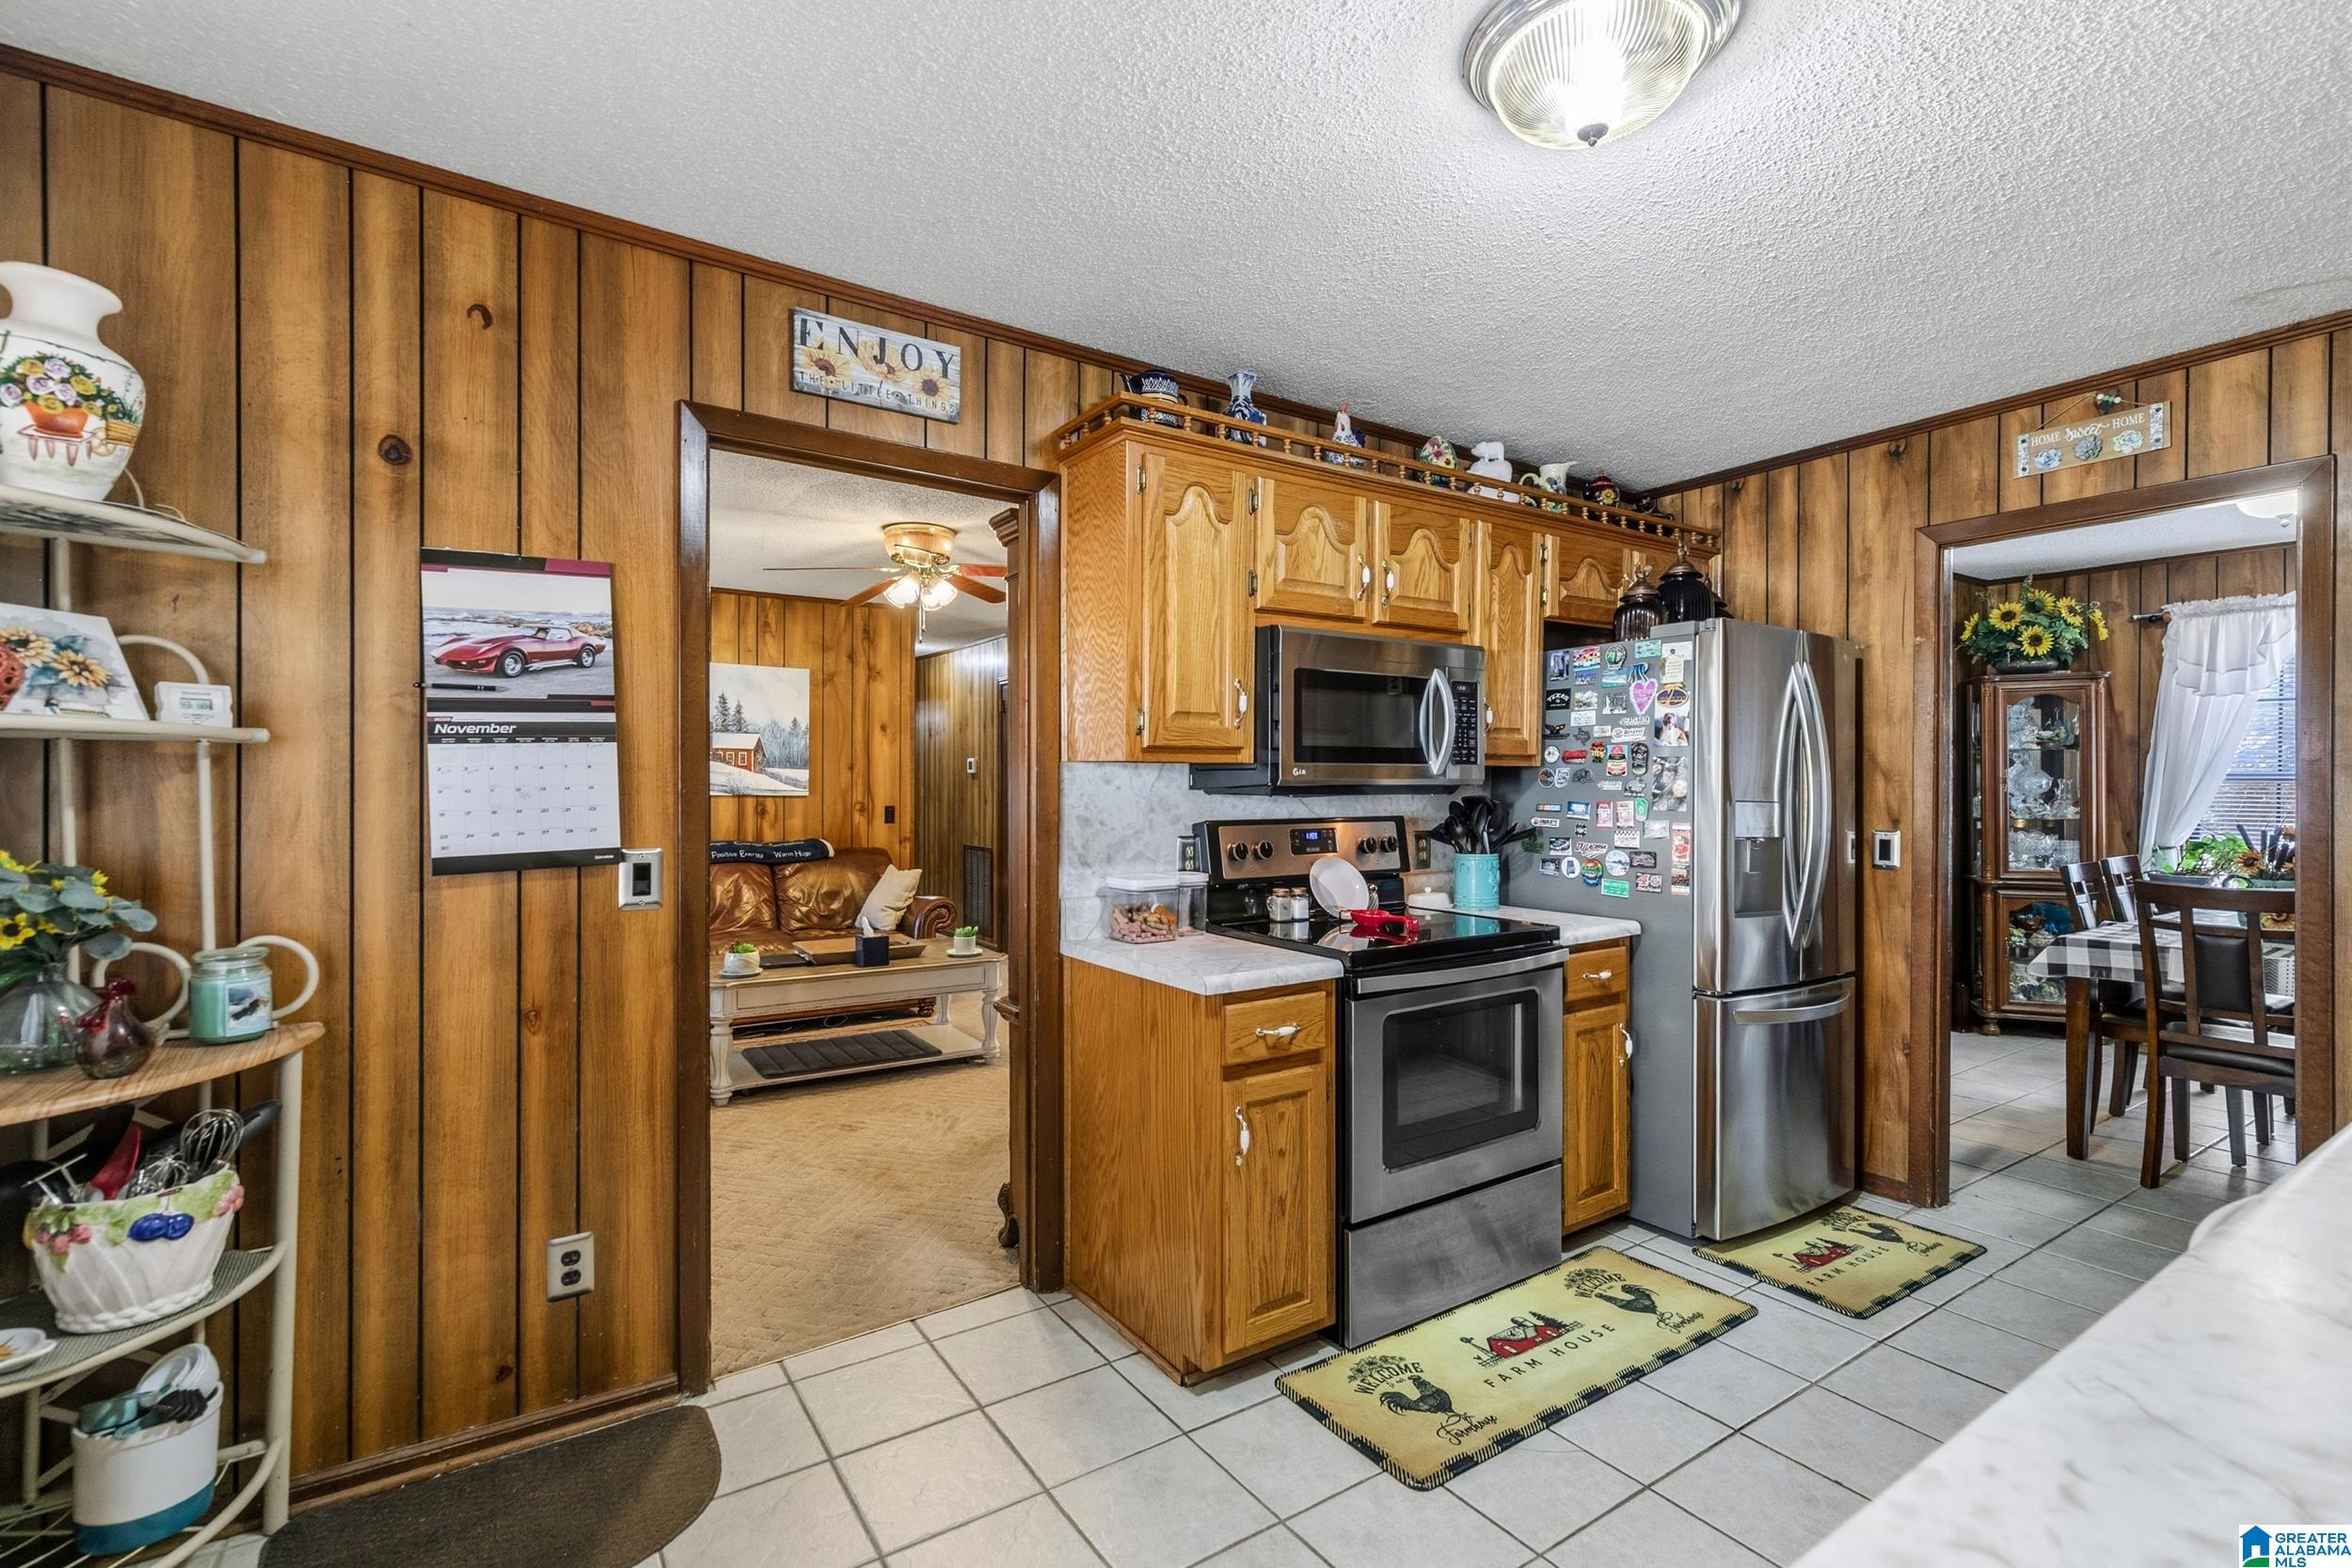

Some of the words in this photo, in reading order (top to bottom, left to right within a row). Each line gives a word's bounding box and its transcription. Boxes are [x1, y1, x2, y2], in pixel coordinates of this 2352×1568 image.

[800, 318, 954, 379] ENJOY
[800, 371, 824, 386] THE
[842, 379, 891, 400] LITTLE
[908, 394, 955, 414] THINGS
[2031, 431, 2061, 447] HOME
[2111, 412, 2145, 430] HOME
[434, 722, 516, 734] November
[710, 850, 738, 859] Positive
[1845, 1245, 1890, 1268] HOUSE
[1574, 1273, 1627, 1299] WELCOME
[1483, 1358, 1543, 1388] FARM
[1549, 1323, 1616, 1357] HOUSE
[1354, 1362, 1424, 1396] WELCOME
[1436, 1413, 1498, 1446] Farmhouse
